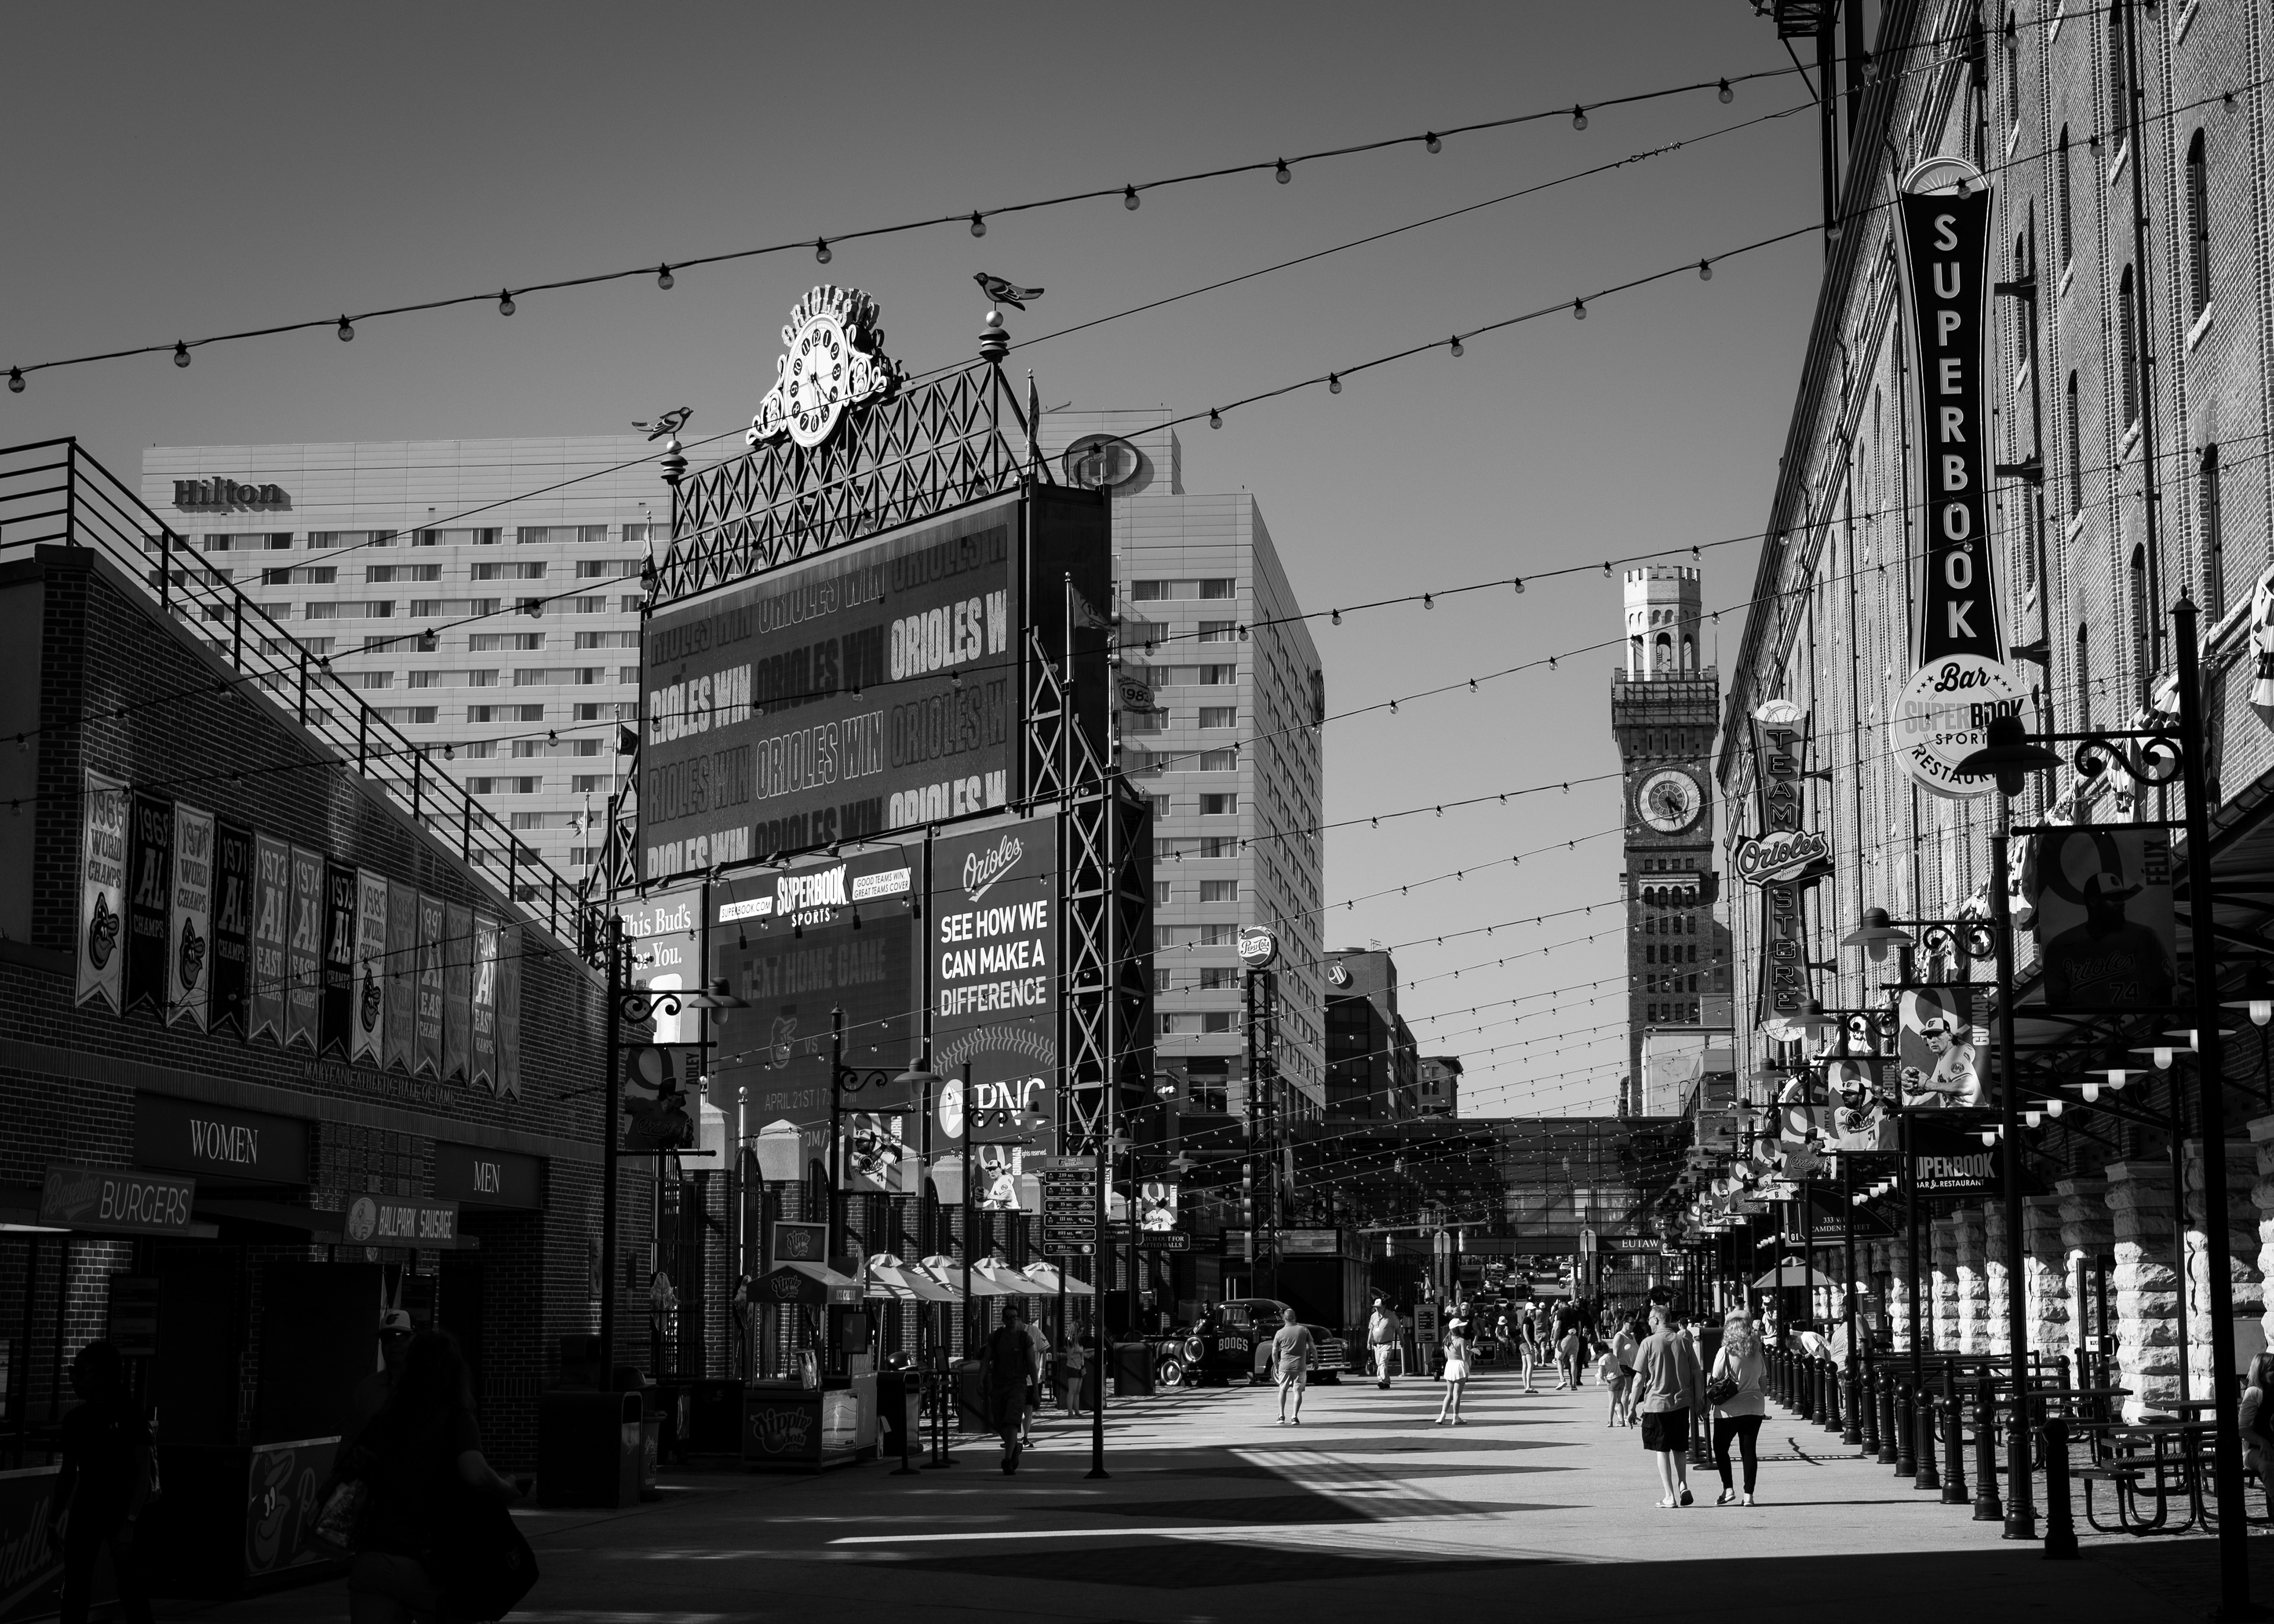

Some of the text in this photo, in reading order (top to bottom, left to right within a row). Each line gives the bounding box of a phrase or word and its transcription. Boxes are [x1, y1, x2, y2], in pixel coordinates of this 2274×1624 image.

[1933, 214, 1977, 639] SUPERBOOK
[172, 476, 282, 504] Hilton
[714, 663, 751, 729] WIN
[757, 638, 839, 716] ORIOLES
[842, 625, 884, 694] WIN
[891, 597, 982, 681] ORIOLES
[1935, 662, 1990, 692] Bar
[714, 744, 750, 810] WIN
[757, 722, 838, 800] ORIOLES
[841, 710, 883, 780] WIN
[891, 683, 981, 768] ORIOLES
[1935, 734, 1988, 745] SPORT
[1767, 729, 1792, 824] TEAM
[261, 848, 287, 887] 1973
[963, 835, 1023, 895] Orioles
[1740, 833, 1823, 874] Orioles
[88, 860, 121, 889] CHAMPS
[134, 847, 165, 911] AL
[296, 860, 320, 898] 1974
[777, 863, 849, 916] SUPERBOOK
[854, 880, 908, 898] GREAT TEAMS COVER
[857, 877, 874, 887] GOOD
[875, 873, 892, 885] TEAMS
[177, 888, 206, 914] CHAMPS
[218, 875, 246, 935] AL
[257, 886, 283, 944] AL
[721, 901, 770, 917] SUPERBOOK.COM
[133, 914, 164, 939] CHAMPS
[293, 897, 318, 954] AL
[791, 908, 830, 928] SPORTS
[941, 899, 1048, 943] SEE HOW WE
[219, 938, 245, 962] CHAMPS
[327, 910, 351, 966] AL
[652, 941, 682, 968] You.
[1772, 890, 1798, 1010] STORE
[256, 946, 282, 977] EAST
[785, 947, 833, 995] HOME
[837, 937, 886, 988] GAME
[942, 938, 1045, 979] CAN MAKE A
[258, 979, 282, 1002] CHAMPS
[326, 969, 351, 991] CHAMPS
[941, 976, 1046, 1017] DIFFERENCE
[2109, 982, 2139, 1005] 74
[293, 986, 315, 1009] CHAMPS
[474, 1008, 493, 1035] EAST
[1971, 994, 1990, 1046] GUNNAR
[805, 1037, 818, 1054] VS
[303, 1061, 455, 1105] MARYLAND ATHLETIC HALL OF FAME
[685, 1053, 699, 1085] ADLEY
[765, 1092, 791, 1111] APRIL
[792, 1089, 814, 1109] 21ST
[974, 1078, 1046, 1128] PNC
[190, 1119, 259, 1164] WOMEN
[474, 1160, 501, 1194] MEN
[1939, 1179, 1984, 1188] RESTAURANT
[46, 1167, 189, 1225] Baseline BURGERS
[378, 1206, 416, 1237] BALLPARK
[420, 1209, 454, 1239] SAUSAGE
[1622, 1239, 1658, 1247] EUTAW
[843, 1289, 856, 1301] CREAM
[1218, 1336, 1249, 1352] BOOG'S
